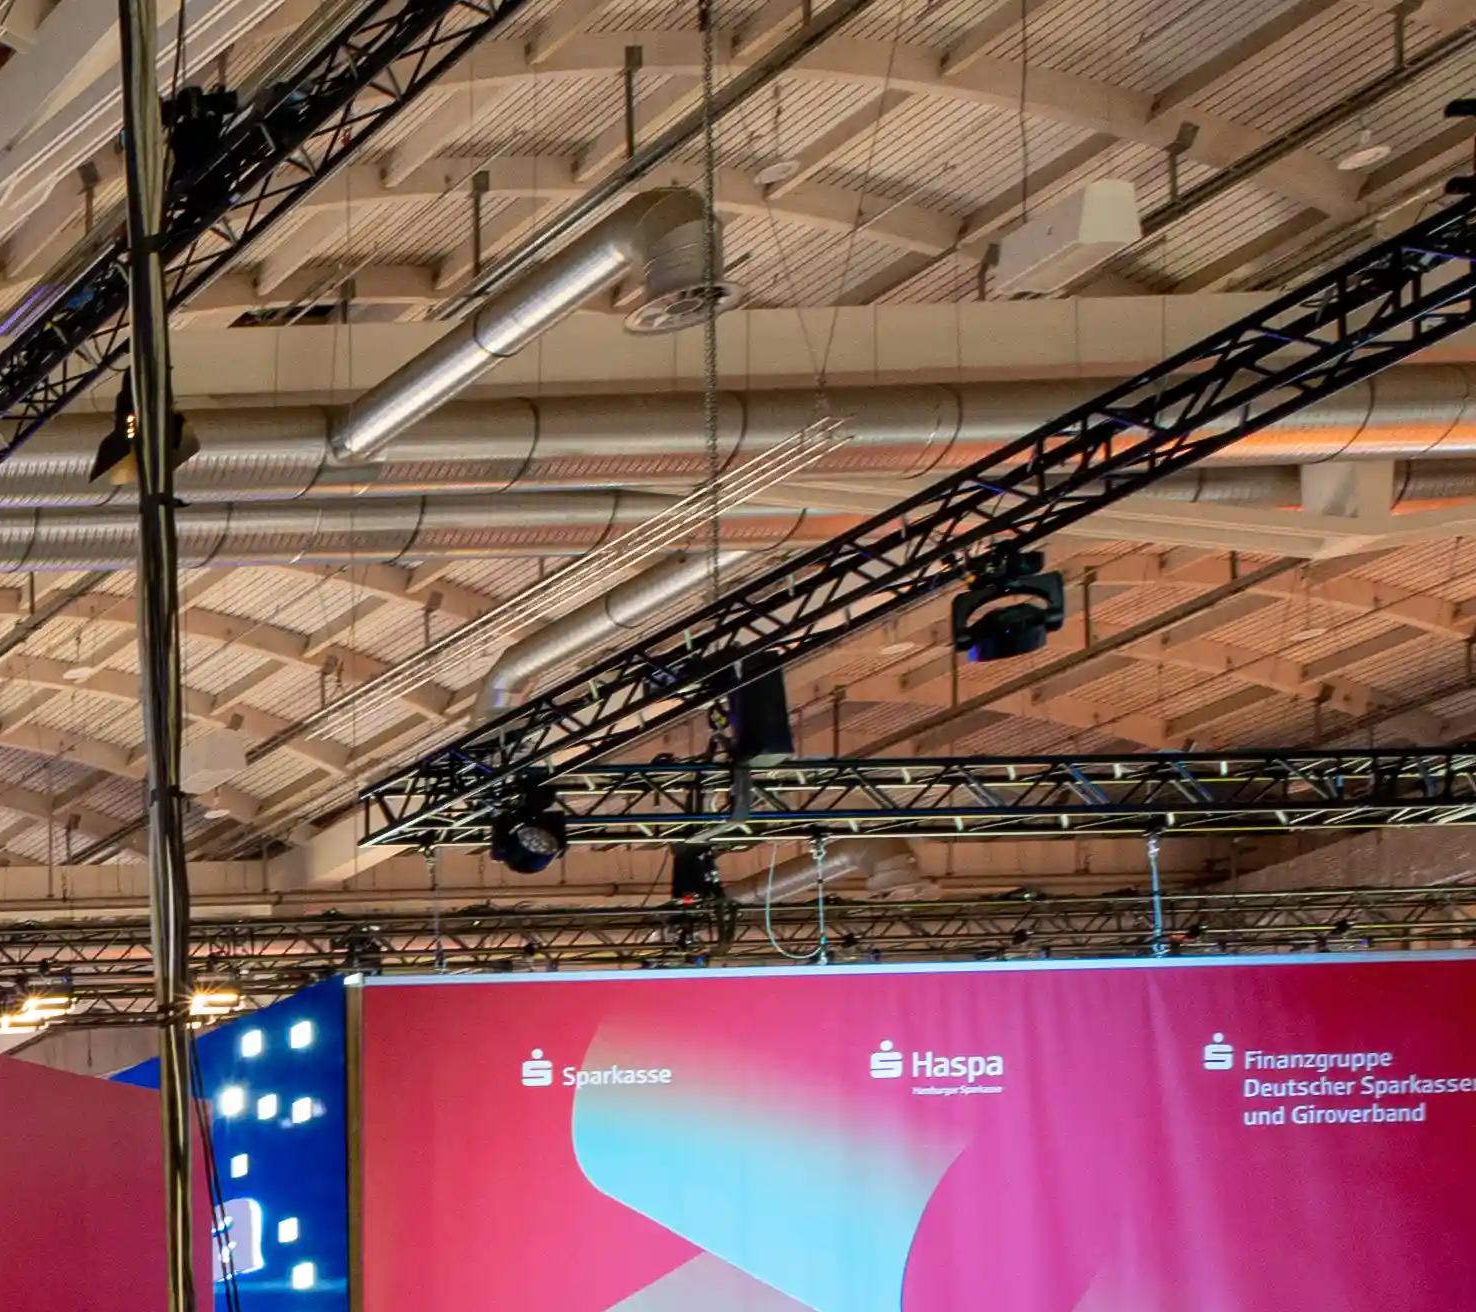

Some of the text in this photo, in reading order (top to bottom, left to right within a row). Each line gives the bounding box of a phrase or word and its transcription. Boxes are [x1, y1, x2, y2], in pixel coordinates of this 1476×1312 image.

[912, 1051, 1004, 1084] Haspa
[1244, 1051, 1394, 1072] Finanzgruppe
[562, 1065, 672, 1089] Sparkasse
[1244, 1077, 1355, 1098] Deutscher
[1244, 1103, 1426, 1125] und Giroverband
